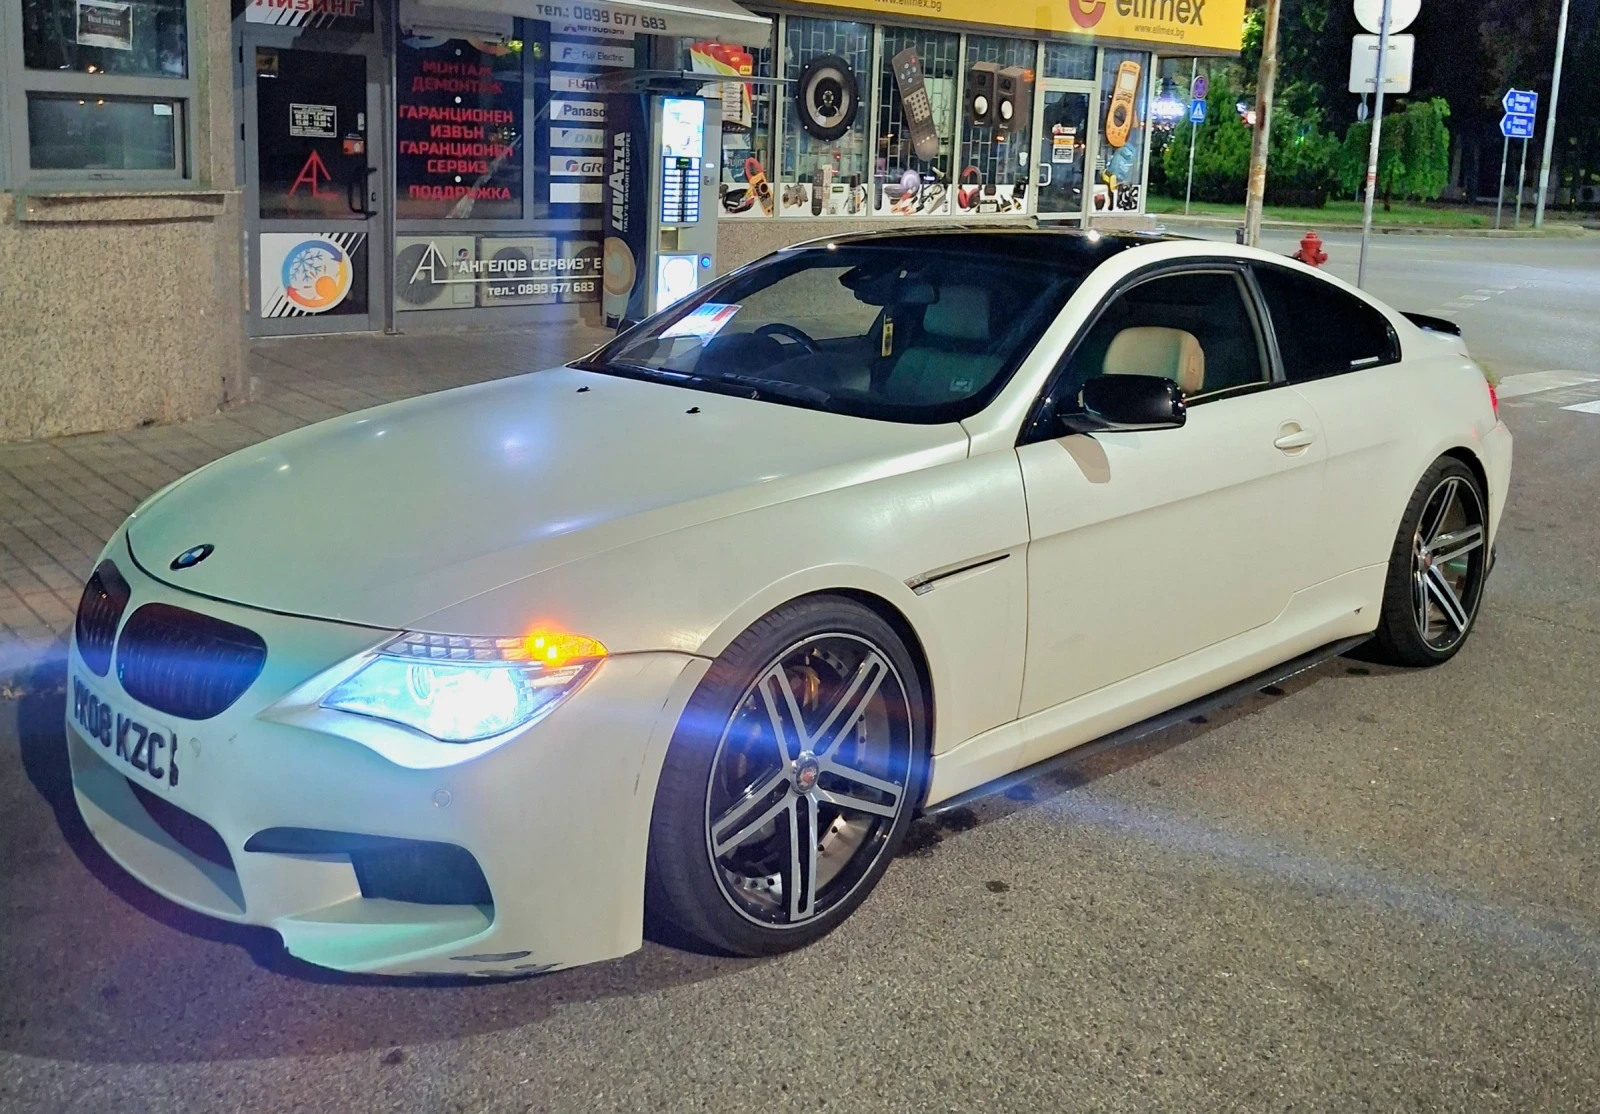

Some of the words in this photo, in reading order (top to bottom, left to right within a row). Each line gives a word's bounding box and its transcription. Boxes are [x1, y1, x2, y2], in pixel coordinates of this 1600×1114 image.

[573, 6, 610, 23] 0899
[614, 12, 637, 27] 677
[641, 16, 667, 31] 683
[1134, 23, 1185, 39] www.elimex.bg
[582, 50, 597, 62] Fuji
[597, 51, 625, 62] Electric
[423, 60, 492, 76] МОНТАЖ
[411, 76, 504, 94] ДЕМОНТАЖ
[399, 104, 513, 123] ГАРАНЦИОНЕН
[430, 124, 485, 139] ИЗВЪН
[399, 141, 514, 158] ГАРАНЦИОНЕН
[427, 159, 489, 174] СЕРВИЗ
[608, 131, 626, 232] LAVAZZA
[518, 284, 548, 295] 0899
[550, 282, 571, 294] 677
[573, 281, 595, 293] 683
[116, 712, 165, 780] KZC
